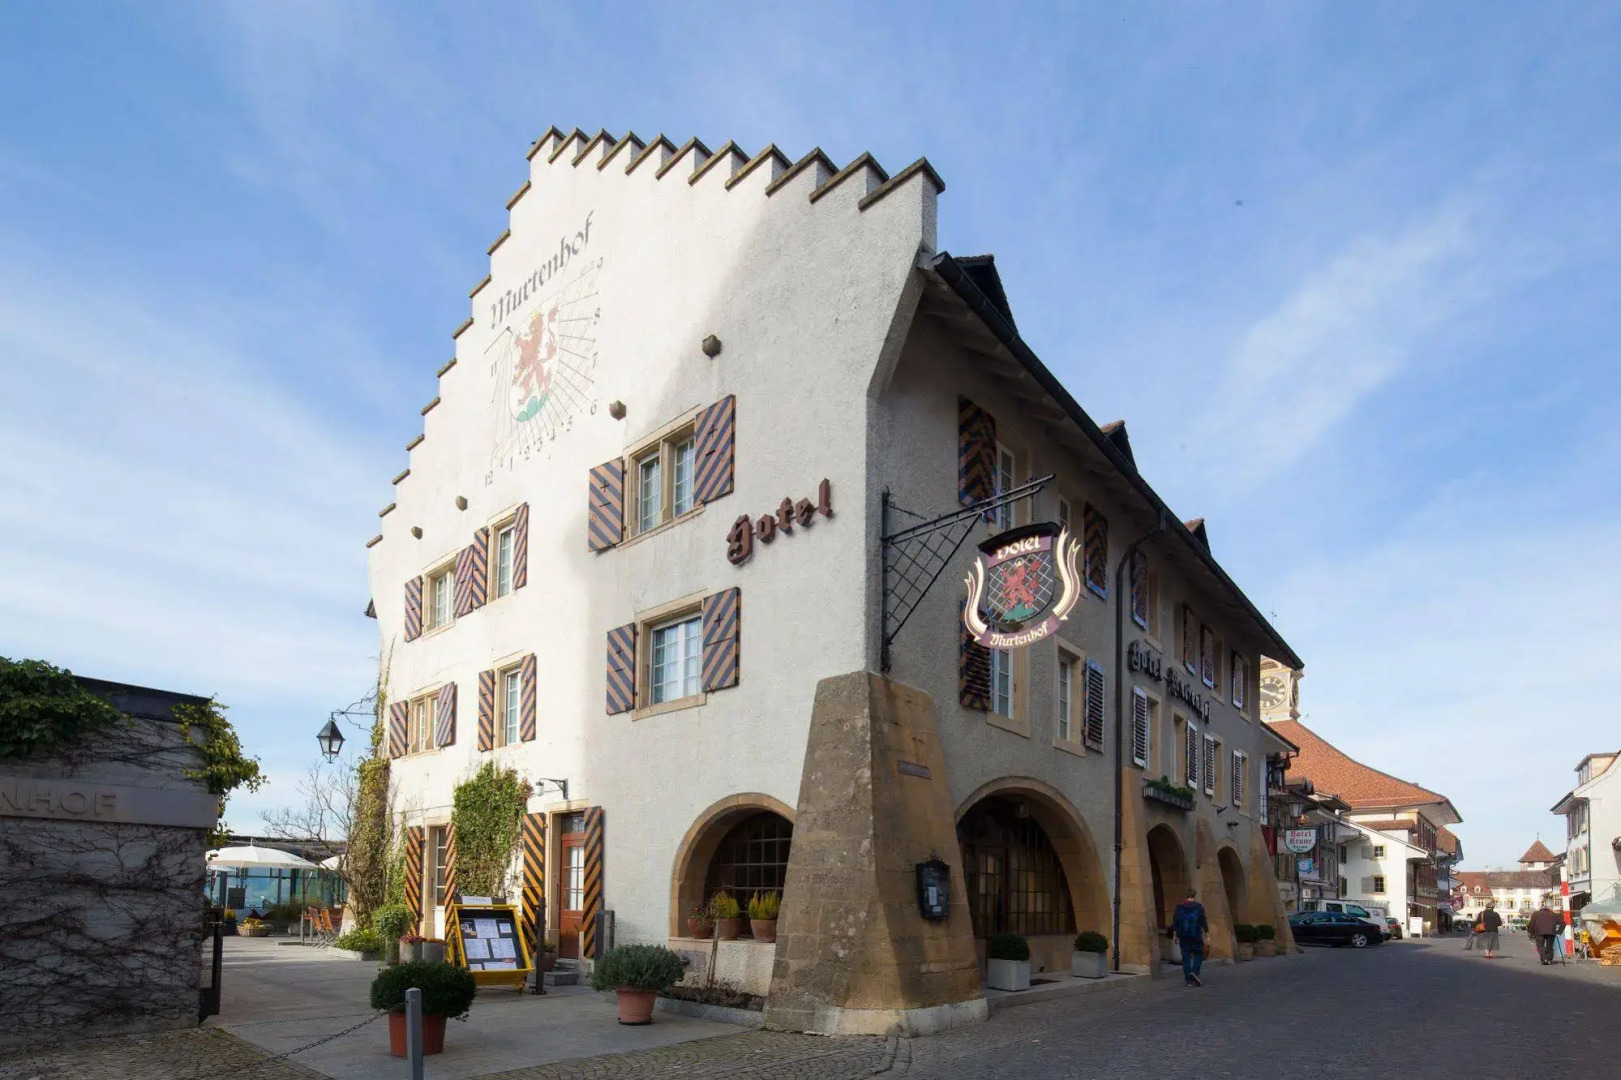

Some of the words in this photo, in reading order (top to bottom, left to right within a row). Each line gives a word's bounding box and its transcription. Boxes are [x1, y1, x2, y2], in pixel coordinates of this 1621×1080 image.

[491, 210, 594, 330] Murtenhof
[589, 399, 597, 416] 6
[989, 621, 1048, 647] Murtenhof
[1290, 830, 1312, 838] Hotel
